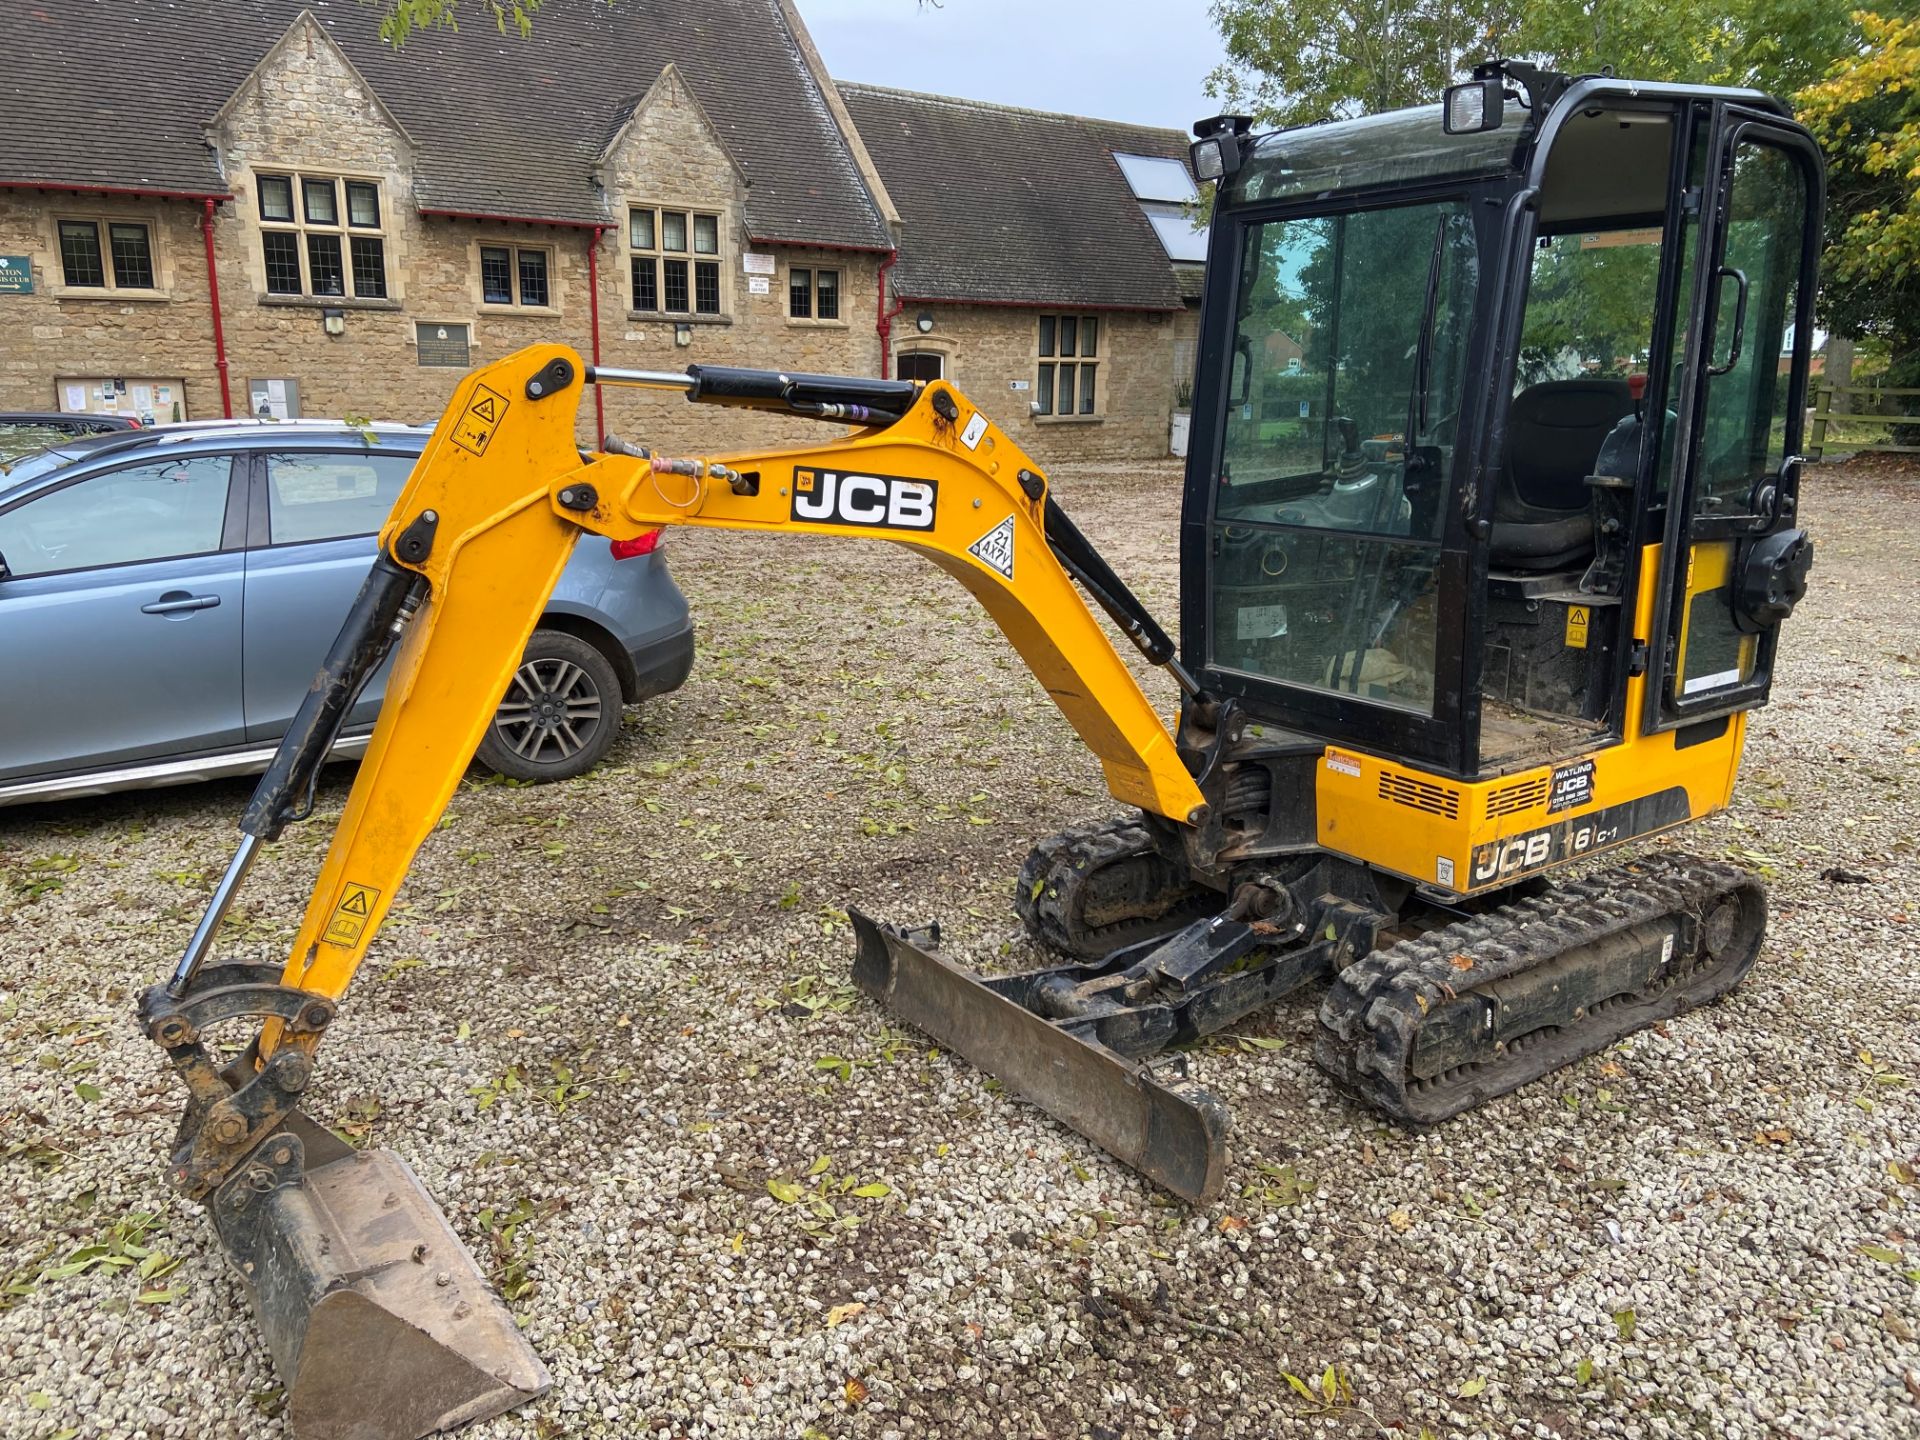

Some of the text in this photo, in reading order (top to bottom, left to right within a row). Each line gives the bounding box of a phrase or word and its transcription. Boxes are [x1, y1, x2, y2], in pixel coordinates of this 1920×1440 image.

[795, 473, 934, 527] JCB
[994, 530, 1009, 550] 21
[1556, 763, 1592, 779] WATLING
[1557, 775, 1588, 794] JCB
[1475, 832, 1551, 880] JCB
